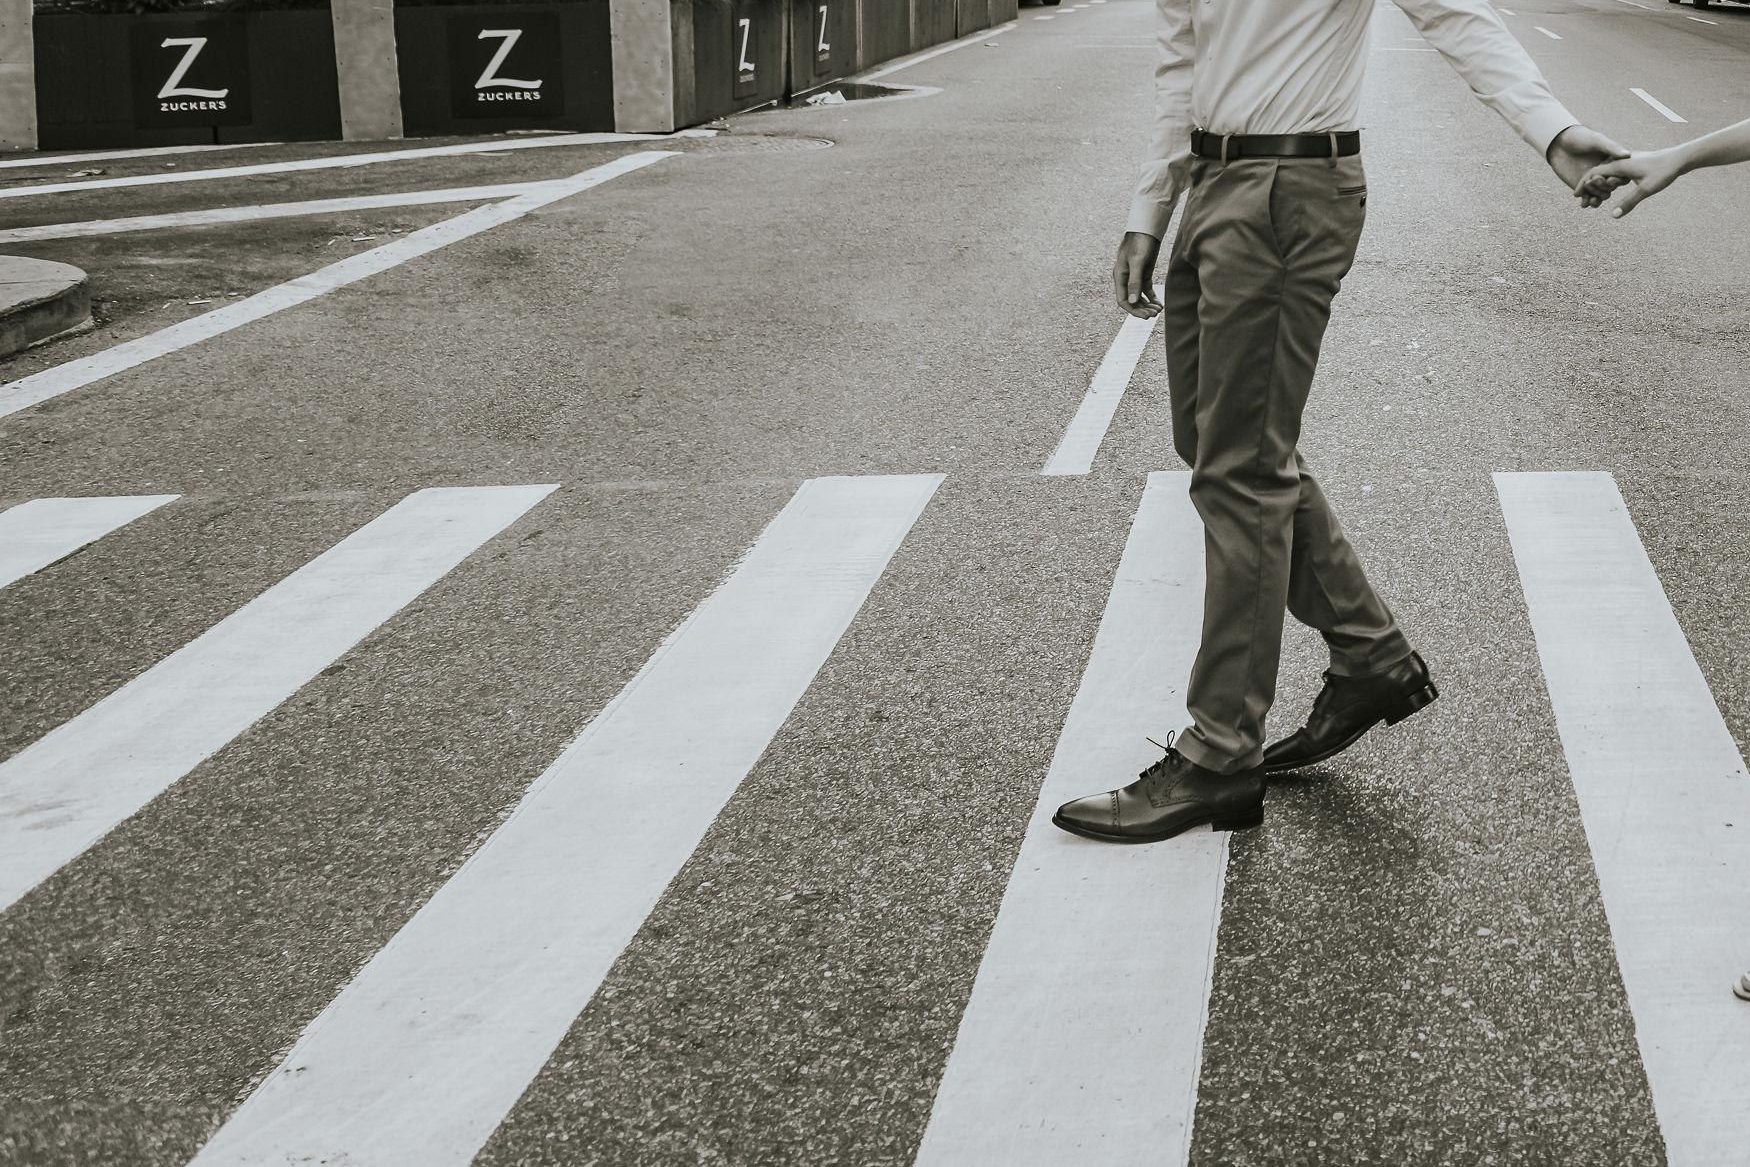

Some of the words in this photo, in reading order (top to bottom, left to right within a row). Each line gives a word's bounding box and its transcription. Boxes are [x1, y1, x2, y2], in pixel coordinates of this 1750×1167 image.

[157, 37, 229, 98] Z
[475, 29, 543, 89] Z
[160, 101, 227, 111] ZUCKER'S
[478, 92, 541, 101] ZUCKER'S
